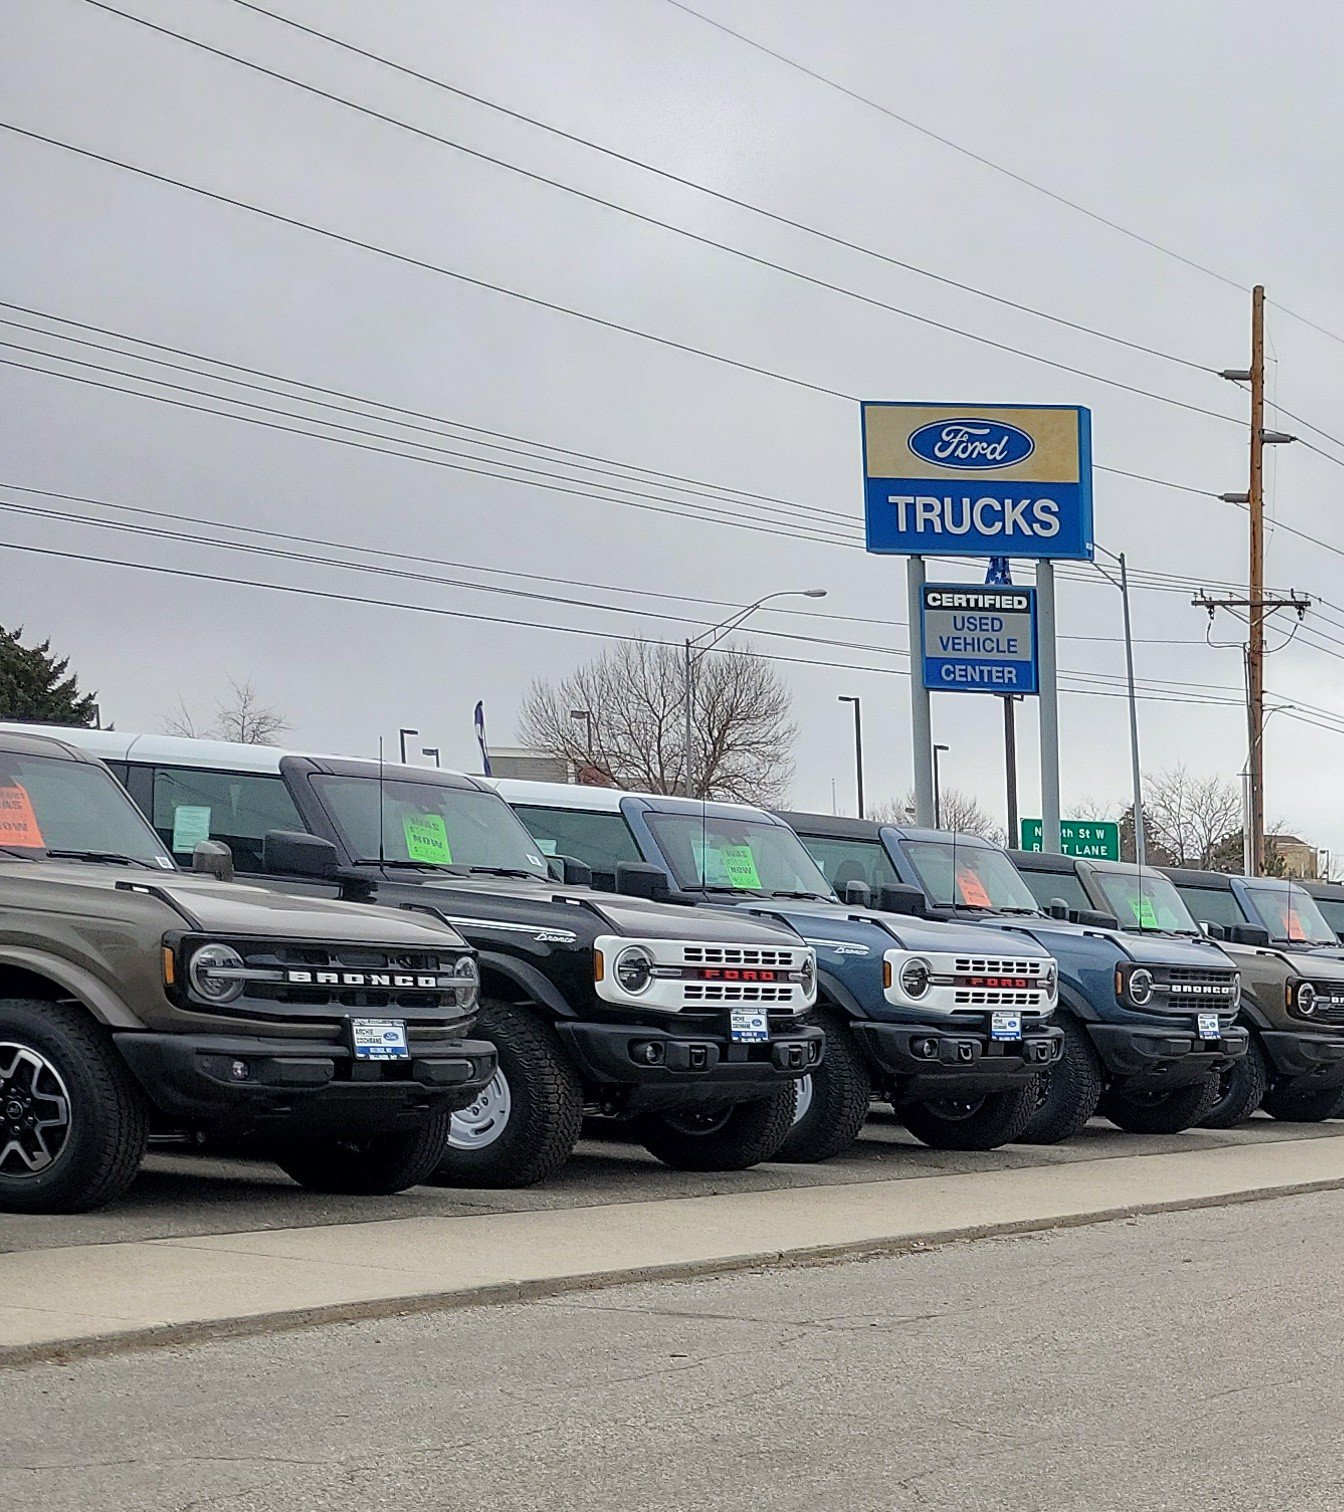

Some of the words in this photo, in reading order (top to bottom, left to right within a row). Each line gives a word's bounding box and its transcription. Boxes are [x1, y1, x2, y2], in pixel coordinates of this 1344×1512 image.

[934, 425, 1009, 460] Ford
[888, 495, 1060, 537] TRUCKS
[927, 593, 1028, 610] CERTIFIED
[953, 615, 1004, 632] USED
[939, 635, 1018, 654] VEHICLE
[941, 664, 1017, 684] CENTER
[1078, 829, 1091, 839] St
[1095, 829, 1105, 840] W
[1075, 844, 1108, 856] LANE
[288, 970, 437, 987] BRONCO
[704, 969, 774, 981] FORD
[971, 977, 1026, 987] FORD
[1171, 984, 1230, 994] BRONCO
